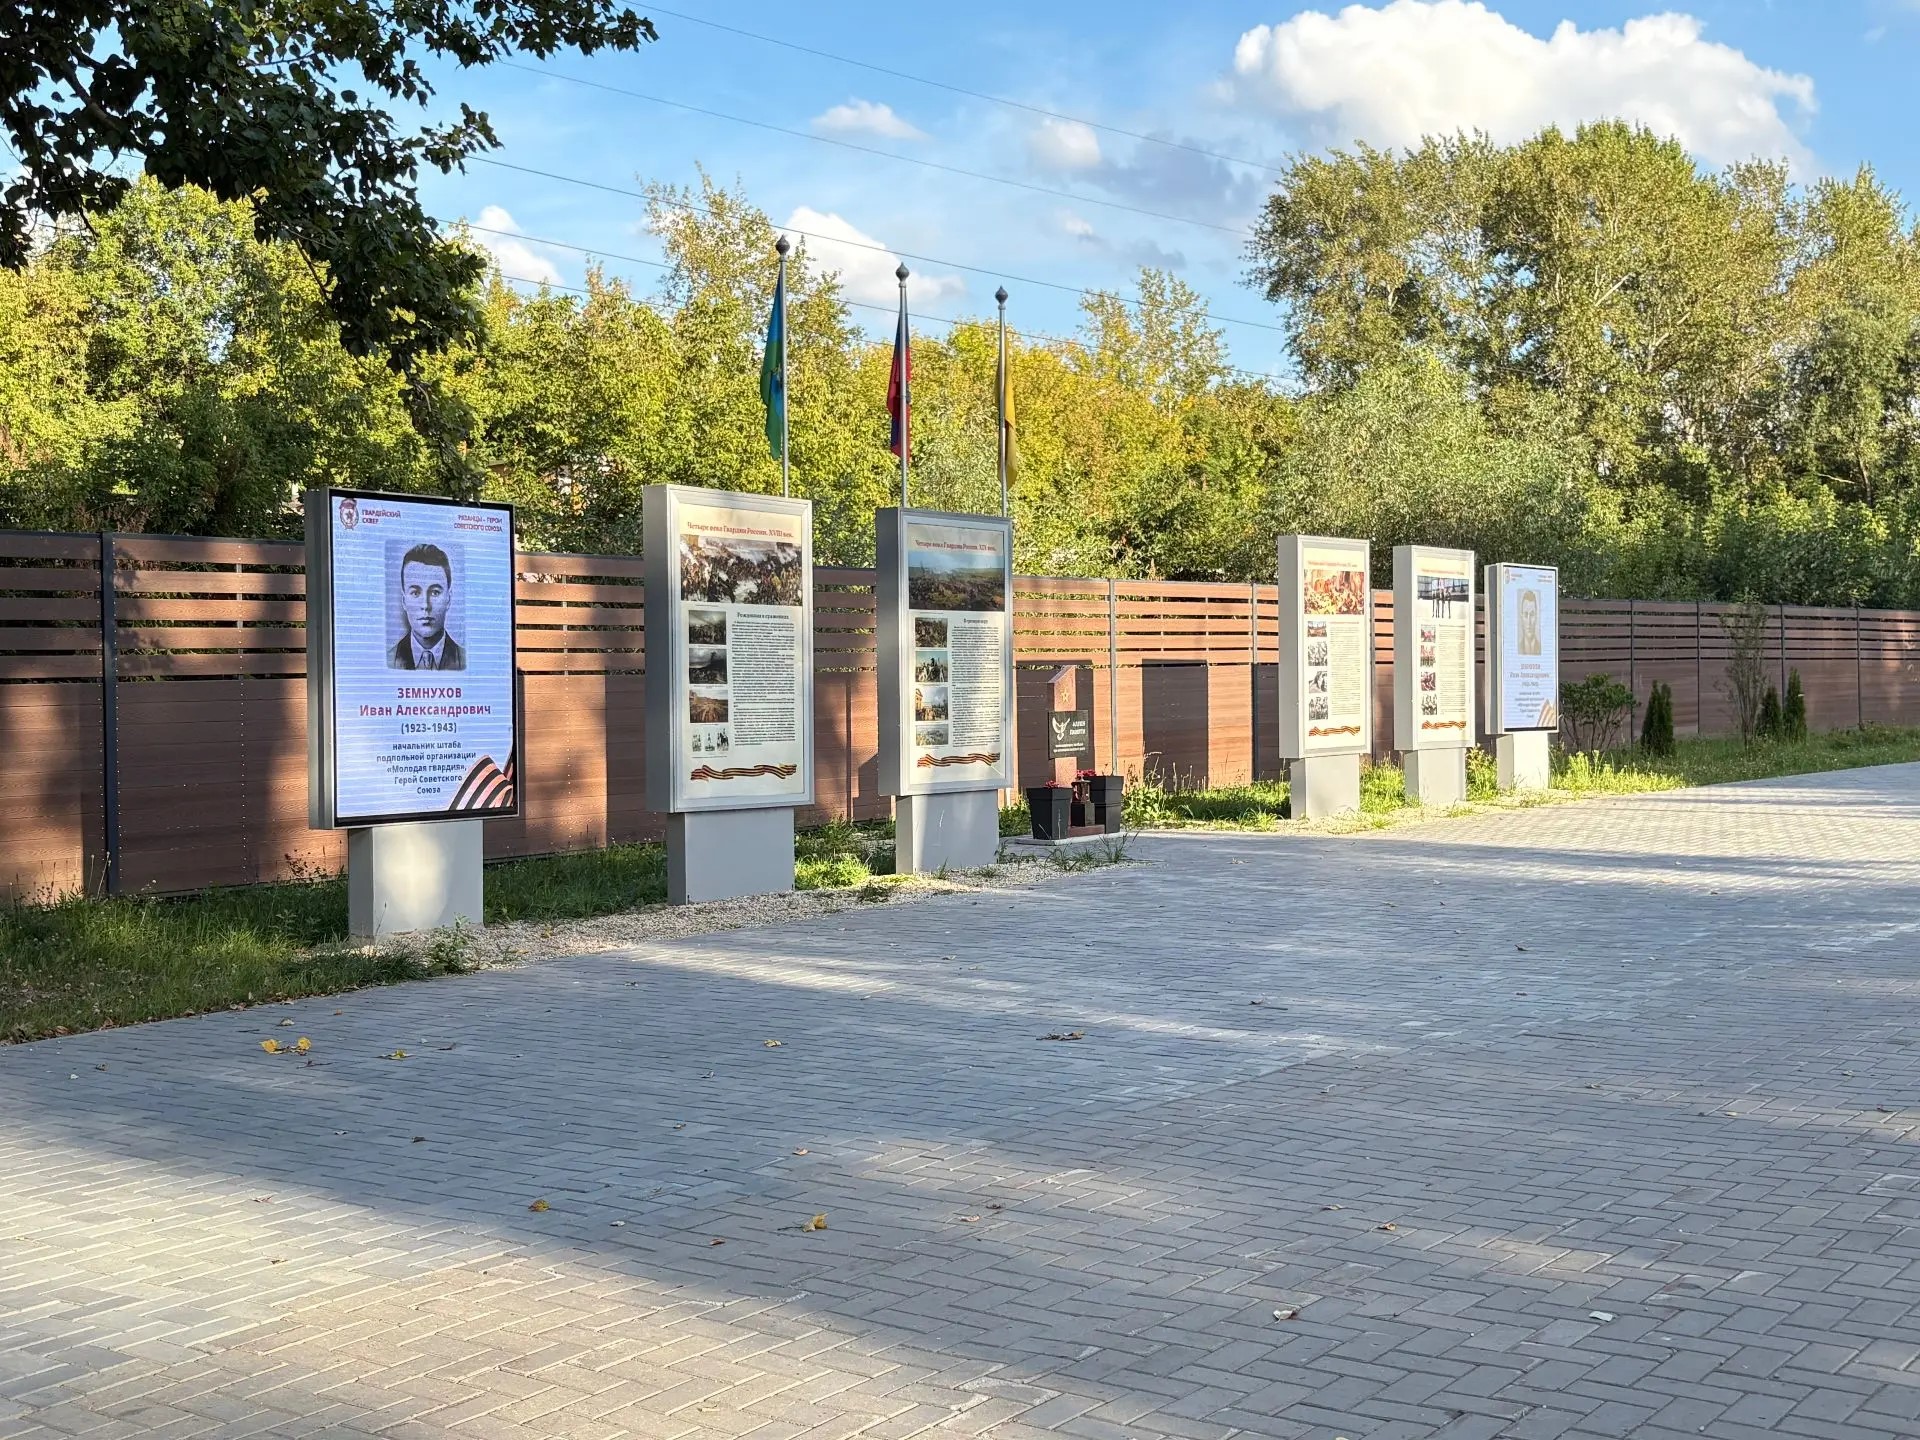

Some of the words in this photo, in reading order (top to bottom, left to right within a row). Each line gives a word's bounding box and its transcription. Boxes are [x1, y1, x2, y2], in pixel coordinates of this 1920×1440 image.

[397, 687, 462, 699] ЗЕМНУХОВ
[359, 705, 392, 716] Иван
[396, 704, 491, 718] Александрович
[392, 742, 436, 751] начальник
[436, 740, 462, 749] штаба
[376, 752, 425, 763] подпольной
[426, 751, 477, 763] организации
[387, 765, 427, 774] «Молодая
[428, 763, 467, 773] гвардия»,
[394, 775, 418, 786] Герой
[419, 774, 463, 783] Советского
[416, 786, 441, 795] Союза
